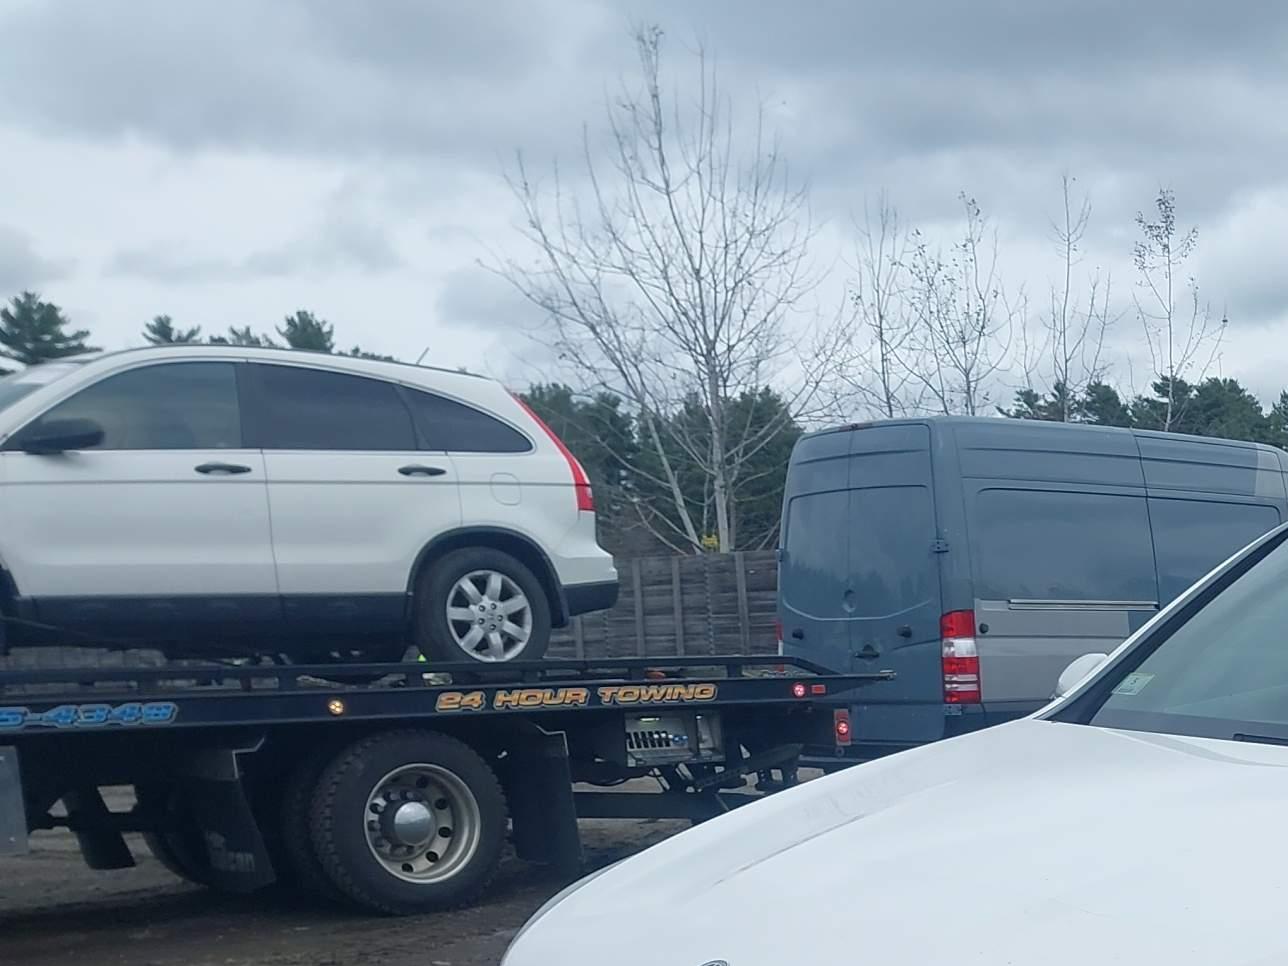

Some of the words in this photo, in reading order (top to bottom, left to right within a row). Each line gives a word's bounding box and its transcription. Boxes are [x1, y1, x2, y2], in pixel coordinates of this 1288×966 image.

[436, 690, 486, 712] 24
[494, 687, 589, 710] HOUR
[597, 683, 718, 704] TOWING
